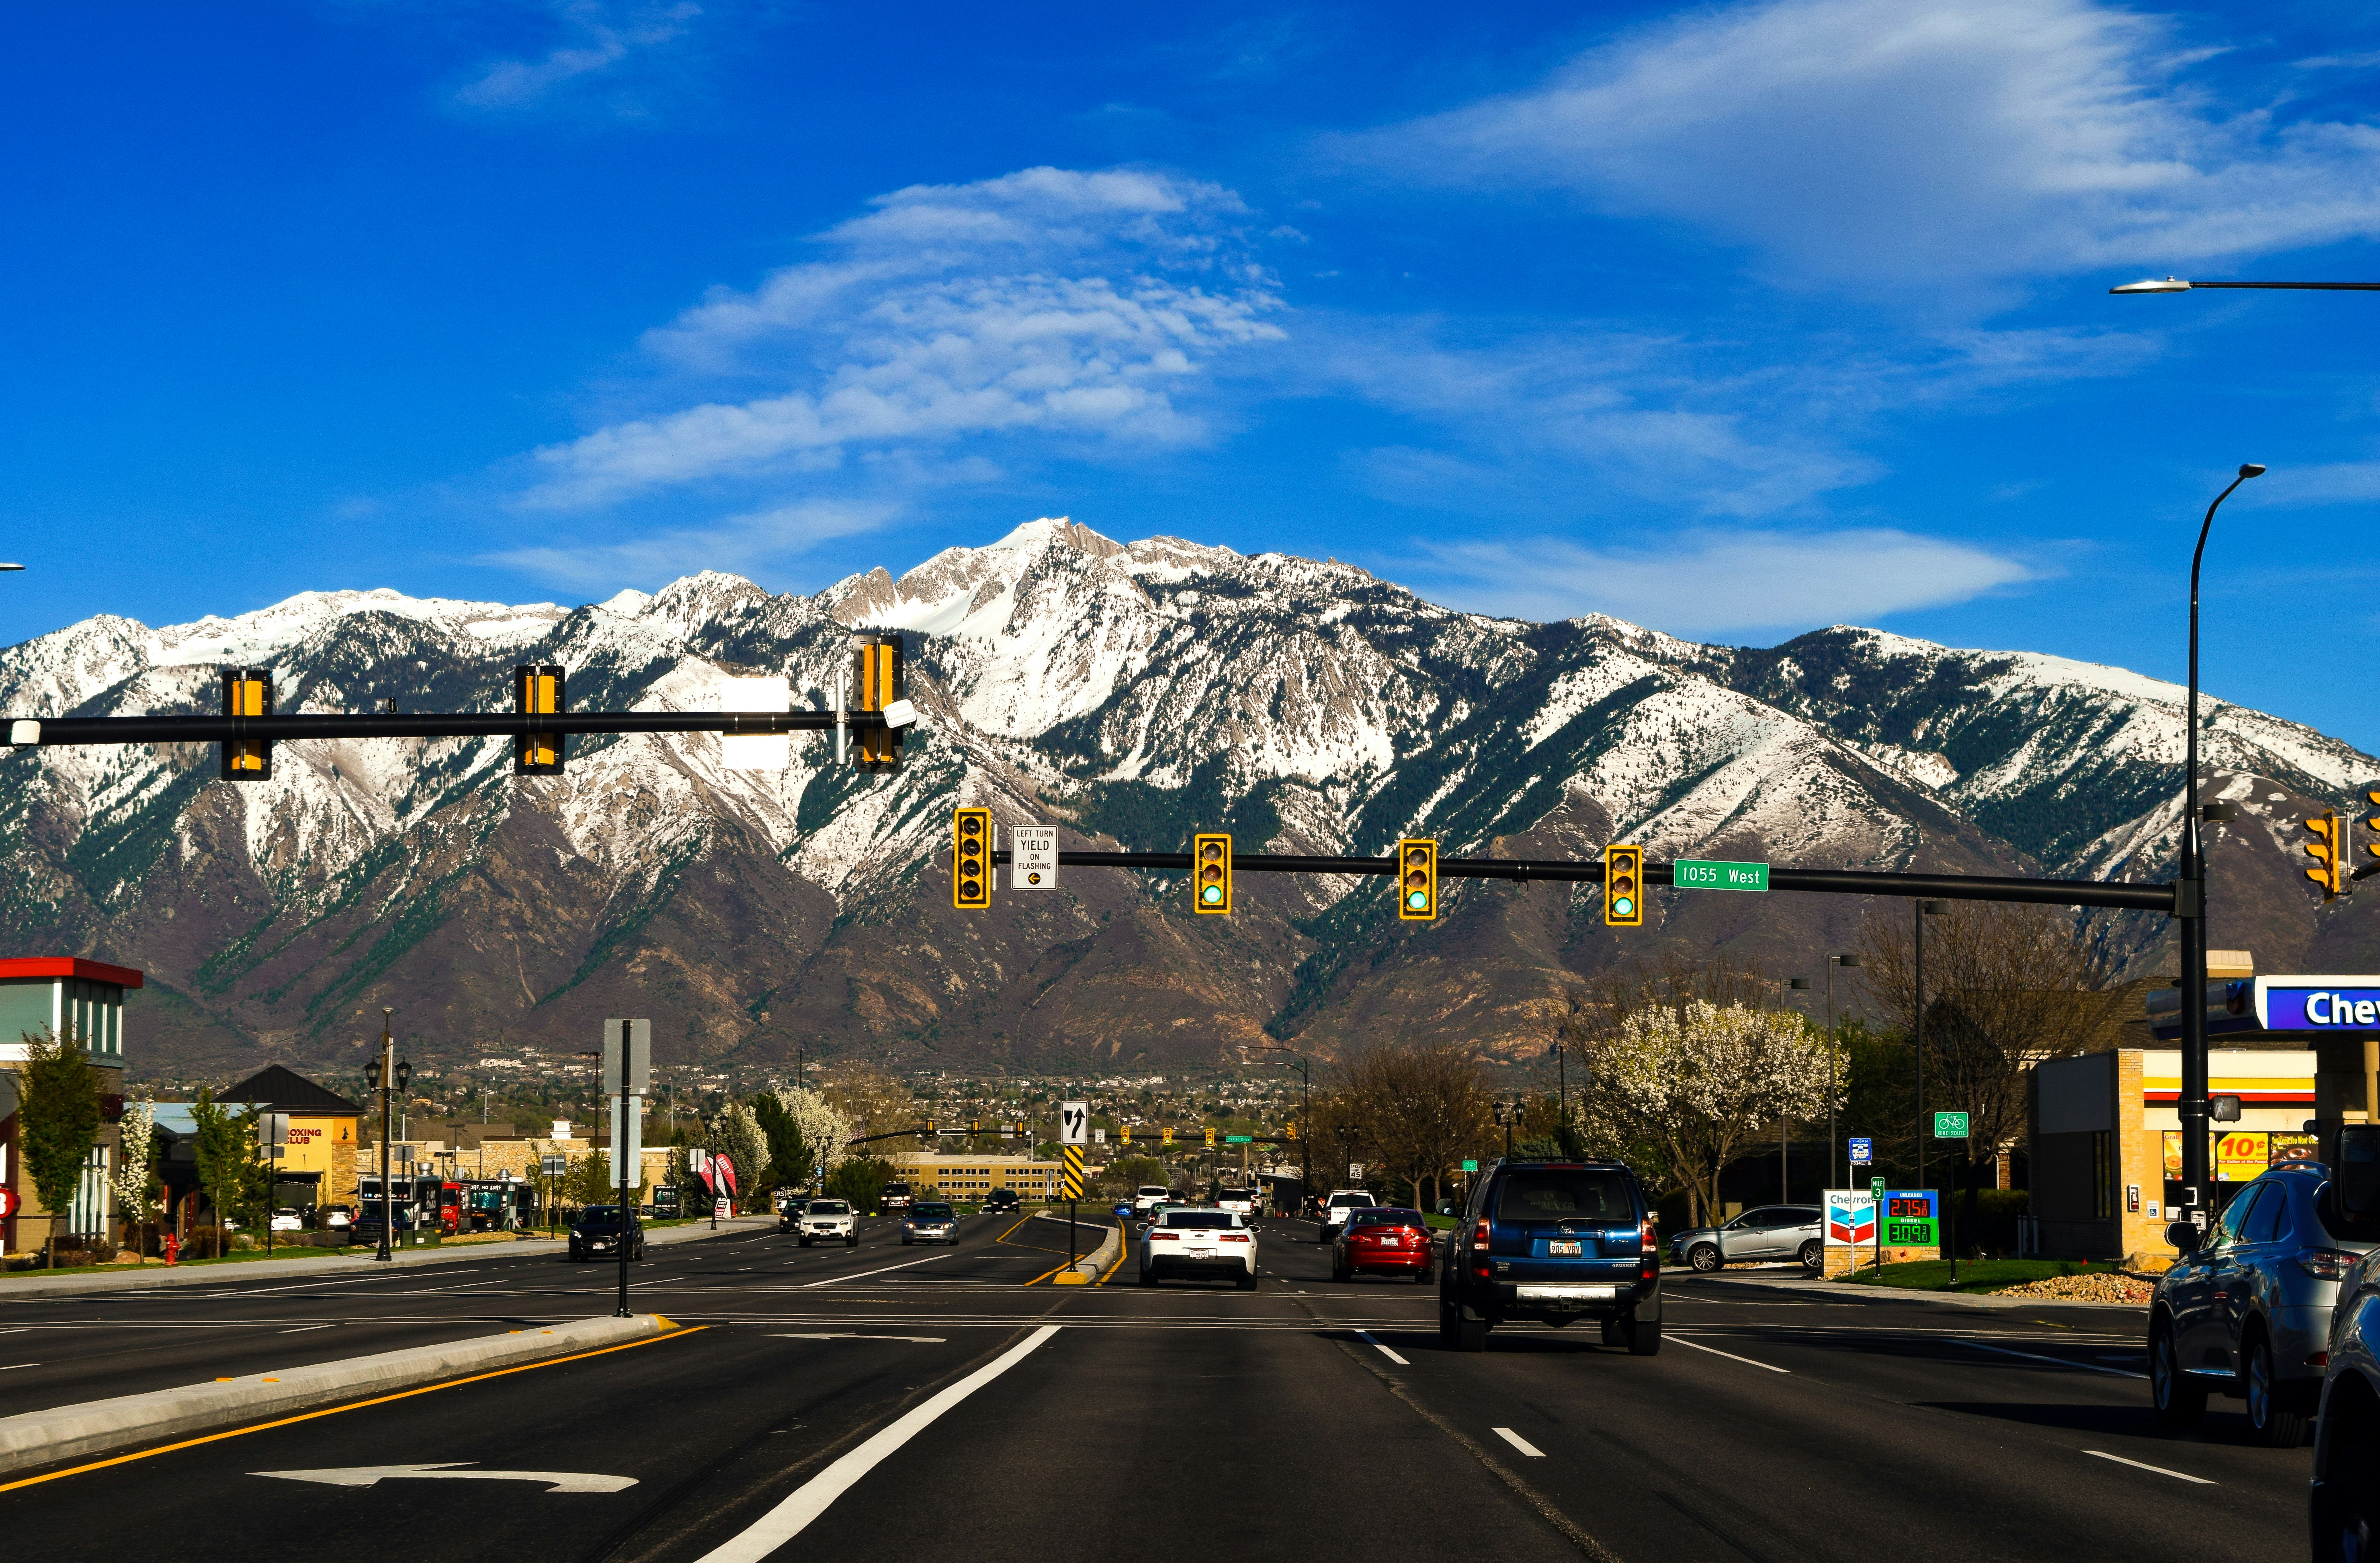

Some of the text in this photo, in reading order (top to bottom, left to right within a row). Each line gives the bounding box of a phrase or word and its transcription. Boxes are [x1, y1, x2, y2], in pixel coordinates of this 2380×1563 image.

[1021, 840, 1049, 850] YIELD
[1683, 867, 1759, 884] 1055 West
[2307, 992, 2380, 1024] Che
[2298, 1136, 2308, 1144] Want
[1875, 1188, 1881, 1197] 3
[1891, 1200, 1921, 1216] 2.75
[1892, 1225, 1921, 1241] 3.09
